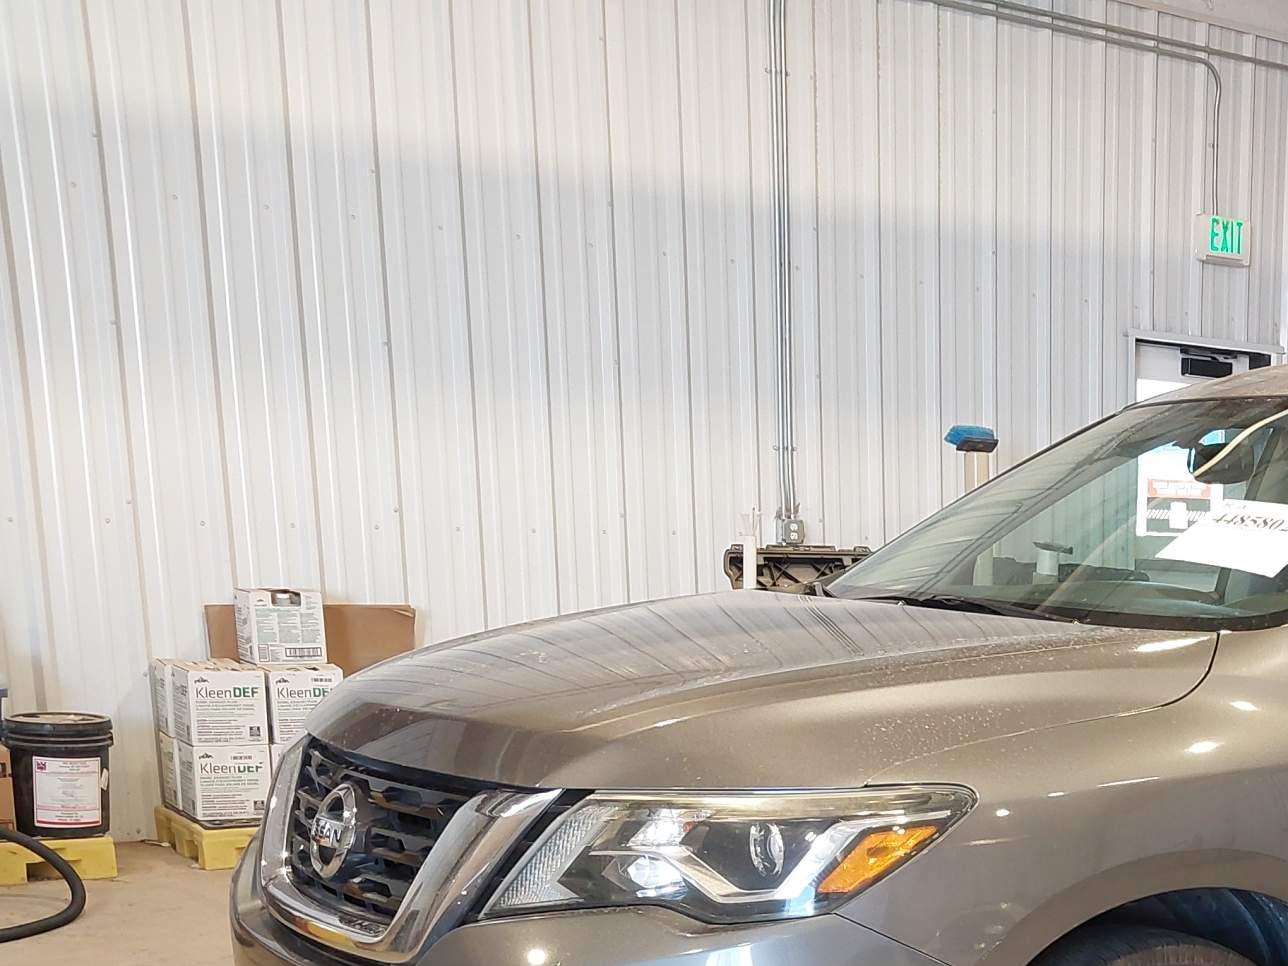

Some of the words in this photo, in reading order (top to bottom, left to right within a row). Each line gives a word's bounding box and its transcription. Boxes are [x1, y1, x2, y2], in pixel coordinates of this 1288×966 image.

[1210, 217, 1243, 255] EXIT
[195, 687, 259, 699] KleenDEF
[277, 687, 333, 699] KleenDE
